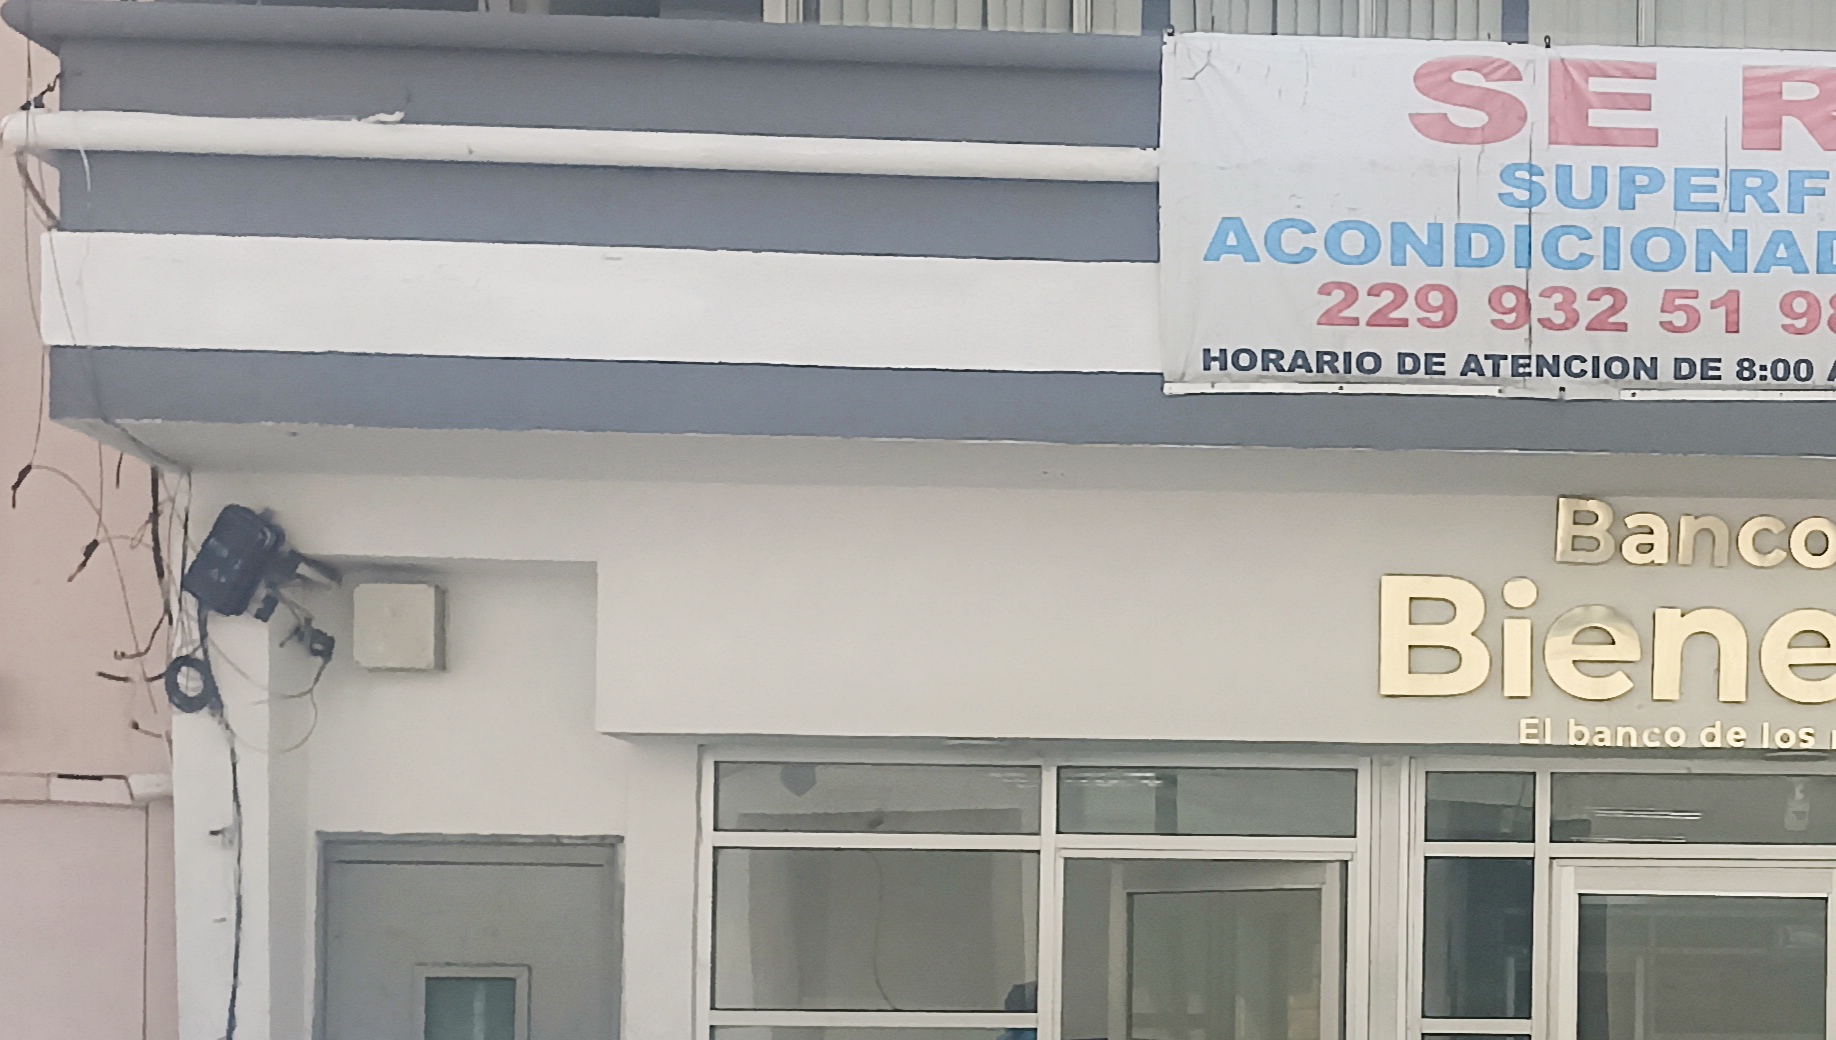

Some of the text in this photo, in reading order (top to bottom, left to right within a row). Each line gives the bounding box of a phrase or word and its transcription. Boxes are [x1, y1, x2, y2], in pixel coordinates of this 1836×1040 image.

[1408, 55, 1659, 148] SE
[1315, 280, 1459, 330] 229
[1487, 285, 1629, 333] 932
[1658, 289, 1742, 335] 51
[1202, 347, 1383, 377] HORARIO
[1398, 351, 1446, 378] DE
[1459, 352, 1660, 382] ATENCION
[1672, 356, 1723, 381] DE
[1735, 356, 1814, 384] 8:00
[1518, 717, 1553, 746] El
[1567, 718, 1687, 749] banco
[1699, 720, 1746, 750] de
[1761, 721, 1816, 750] los
